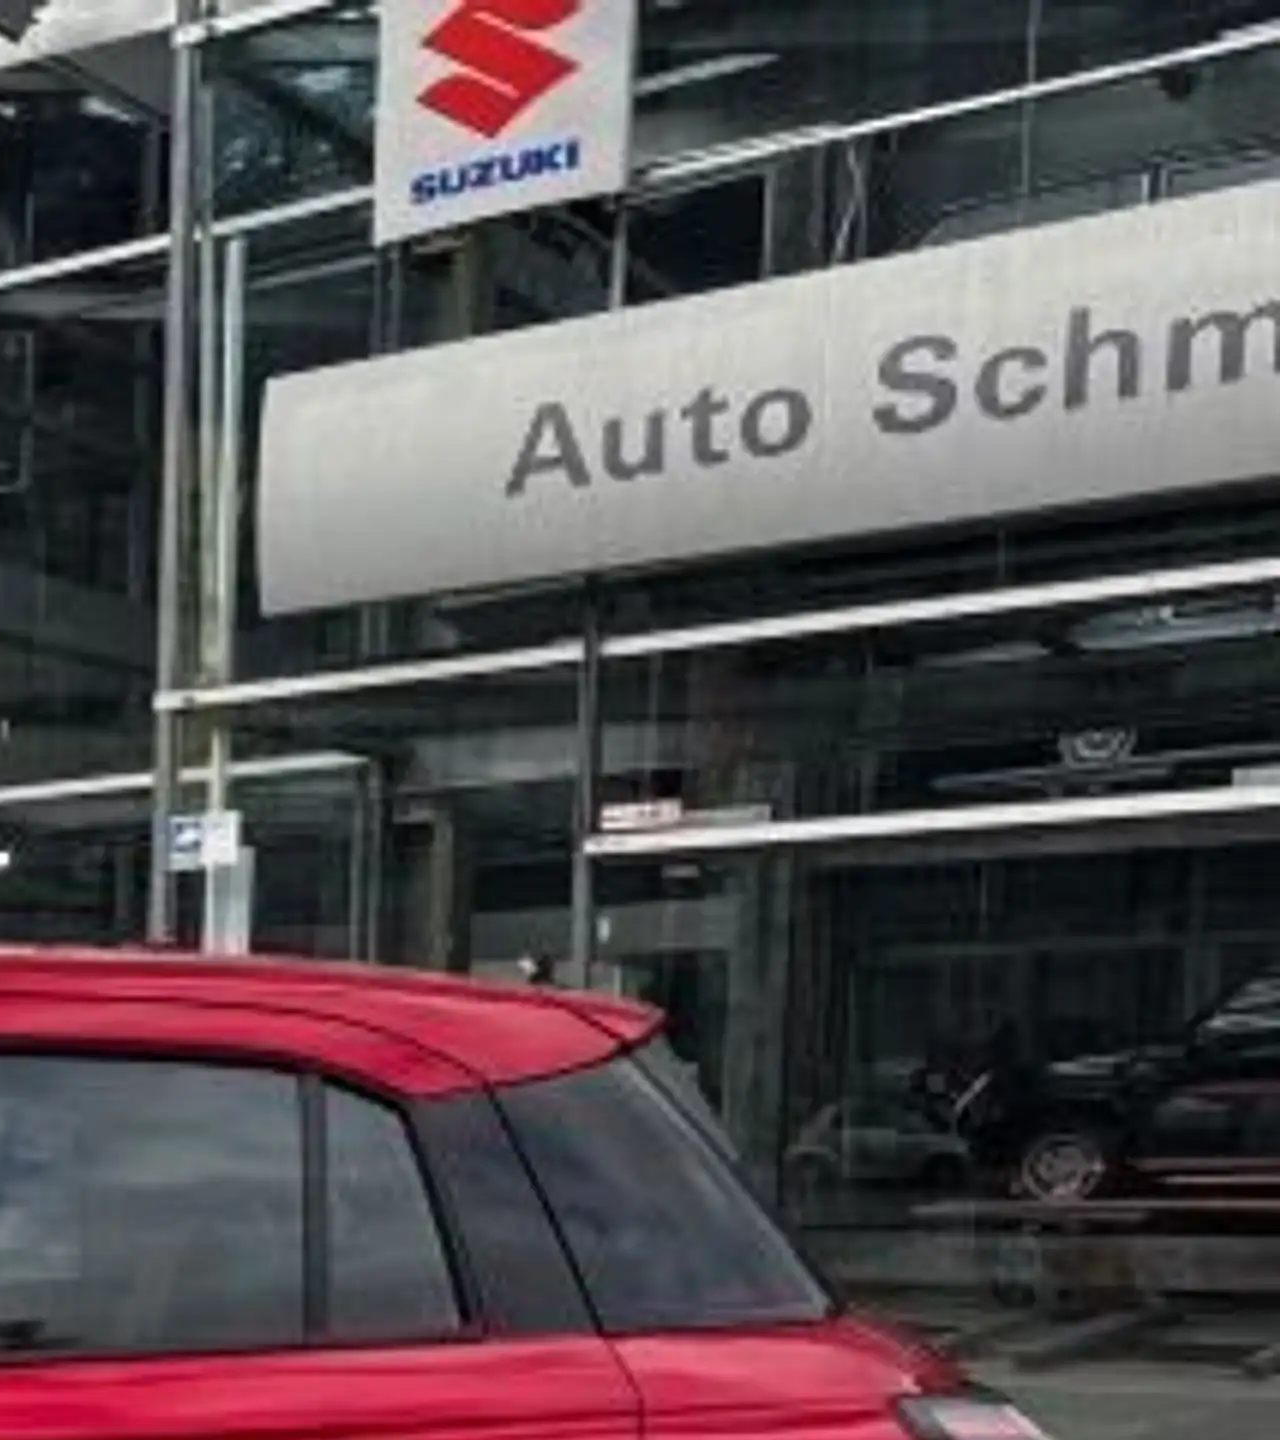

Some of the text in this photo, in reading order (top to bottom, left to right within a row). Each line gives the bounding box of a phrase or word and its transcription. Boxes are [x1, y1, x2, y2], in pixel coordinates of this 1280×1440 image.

[410, 139, 580, 204] SUZUKI
[505, 299, 1280, 498] Auto Schm
